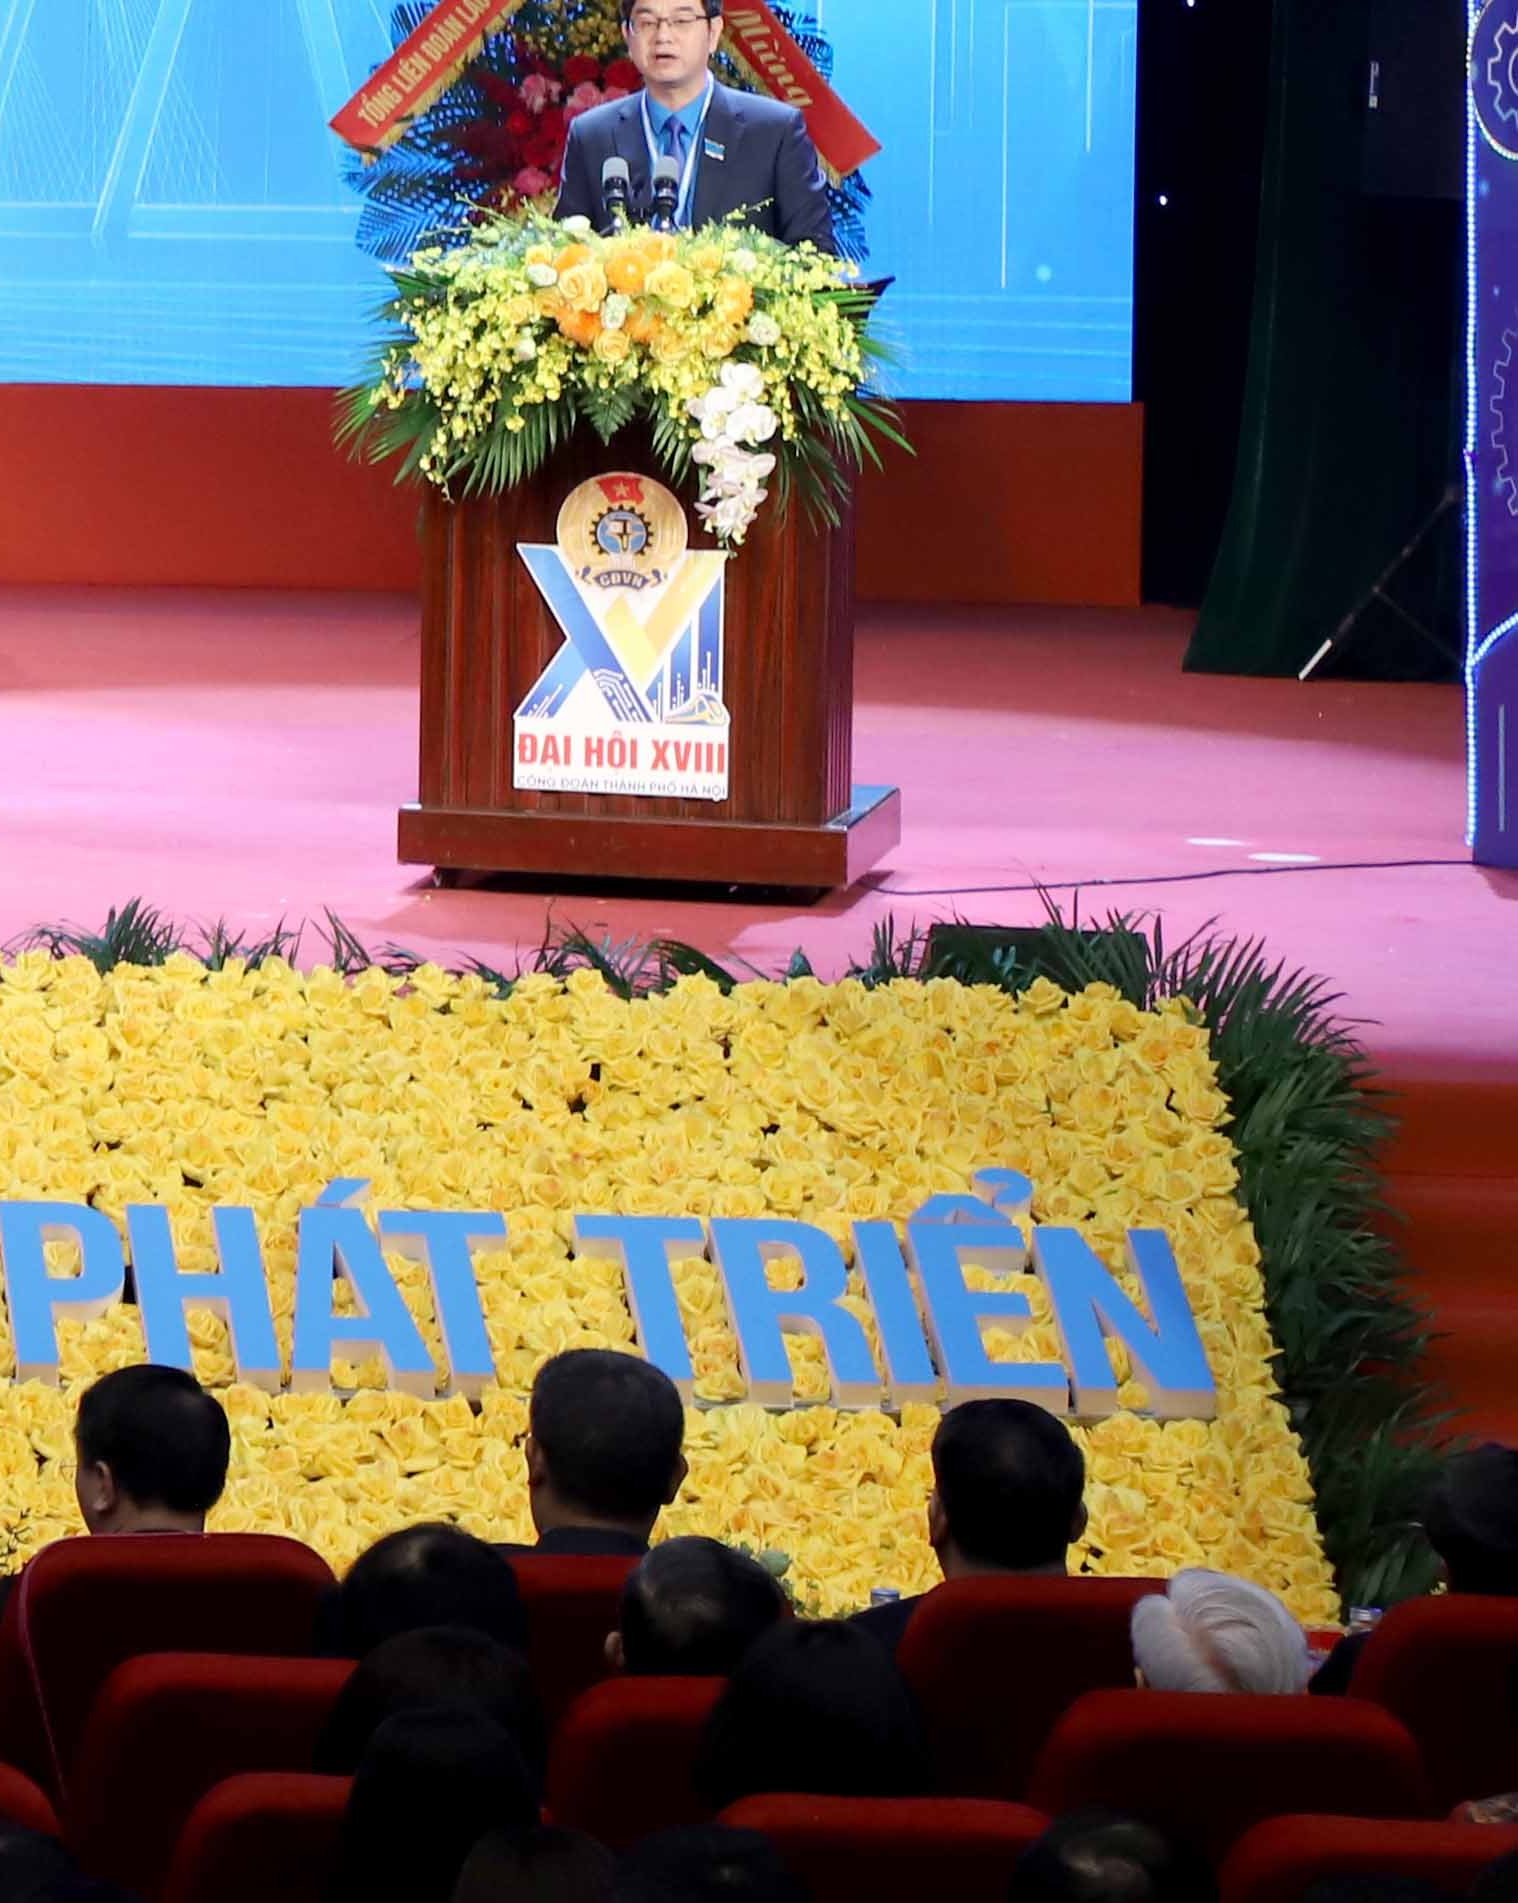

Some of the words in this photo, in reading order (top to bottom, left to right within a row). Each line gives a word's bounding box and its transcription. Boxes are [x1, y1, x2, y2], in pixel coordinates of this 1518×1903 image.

[357, 84, 404, 129] TỔNG
[392, 52, 433, 94] LIÊN
[420, 13, 467, 63] ĐOÀN
[516, 774, 555, 787] CÔNG
[560, 776, 599, 789] ĐOÀN
[603, 778, 646, 792] THÀNH
[651, 738, 725, 774] XVIII
[575, 1167, 1216, 1401] TRIỂN
